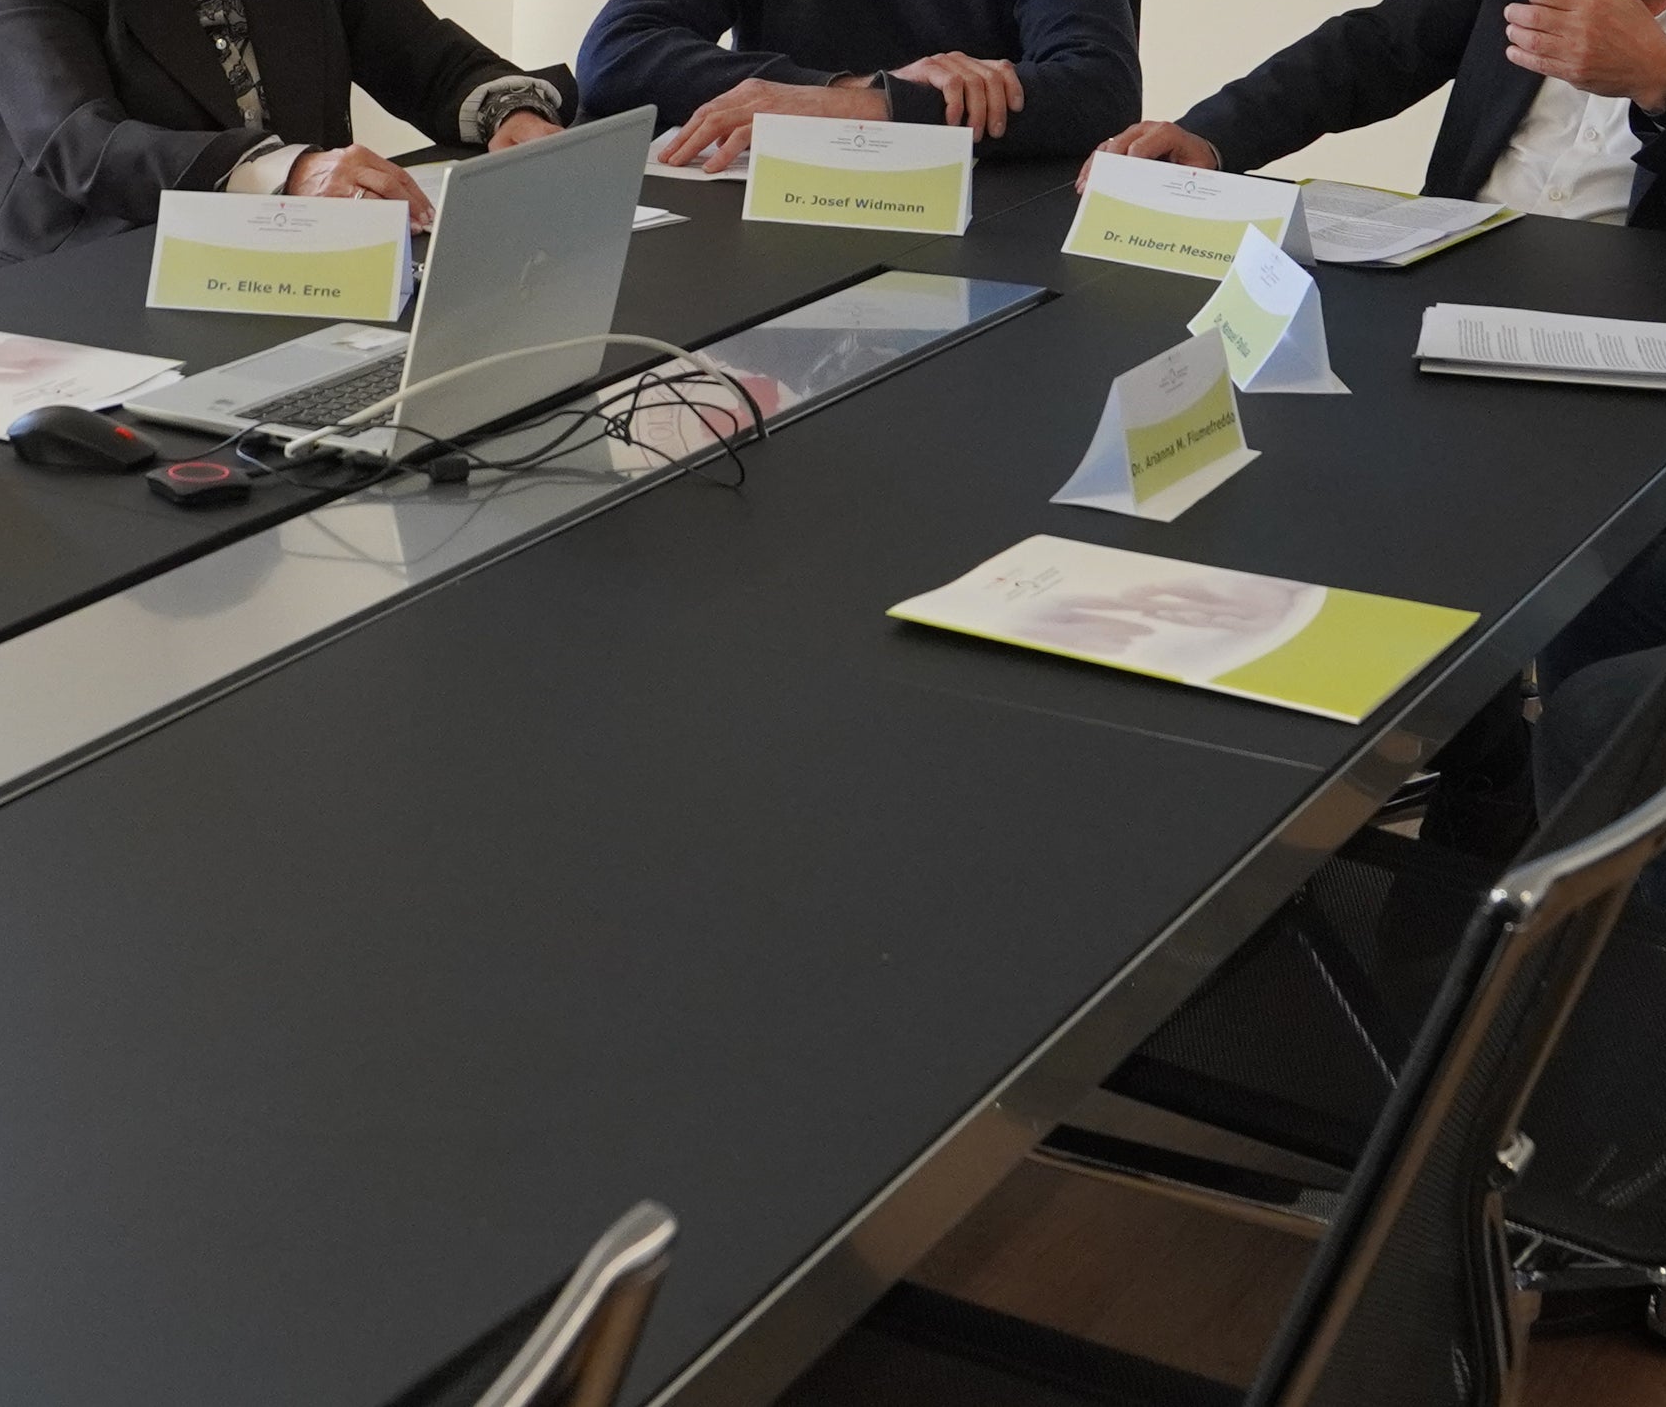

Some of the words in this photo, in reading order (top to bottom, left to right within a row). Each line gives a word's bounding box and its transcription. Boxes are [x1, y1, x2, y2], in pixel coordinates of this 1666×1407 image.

[784, 193, 807, 206] Dr.
[811, 194, 851, 209] Josef
[854, 197, 926, 214] Widmann
[1103, 230, 1123, 243] Dr.
[1128, 235, 1177, 254] Hubert
[206, 278, 231, 292] Dr.
[237, 280, 273, 295] Elke
[278, 283, 297, 296] M.
[302, 285, 342, 298] Erne
